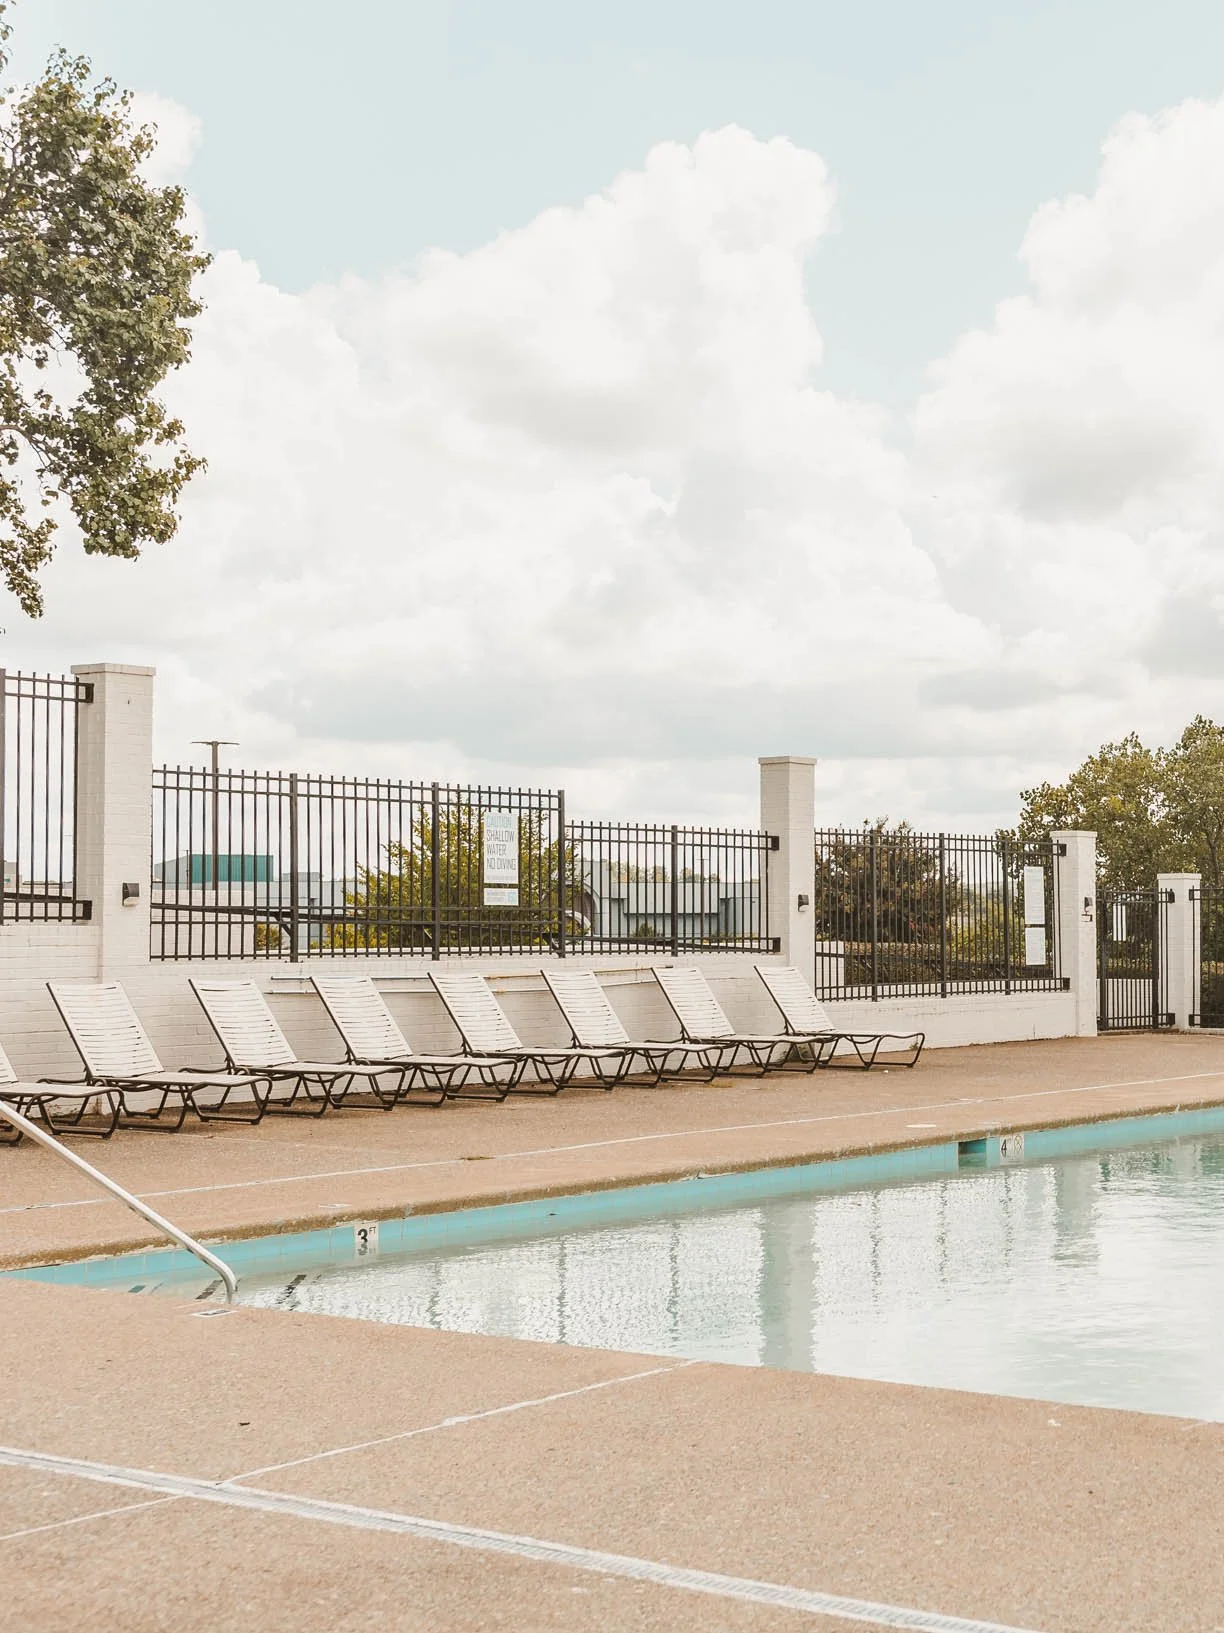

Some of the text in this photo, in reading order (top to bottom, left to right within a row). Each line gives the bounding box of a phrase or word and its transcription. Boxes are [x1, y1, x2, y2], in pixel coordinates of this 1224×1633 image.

[486, 830, 514, 842] SHALLOW
[486, 844, 506, 856] WATER
[486, 858, 516, 870] NO DIVING
[358, 1226, 376, 1242] 3 FT
